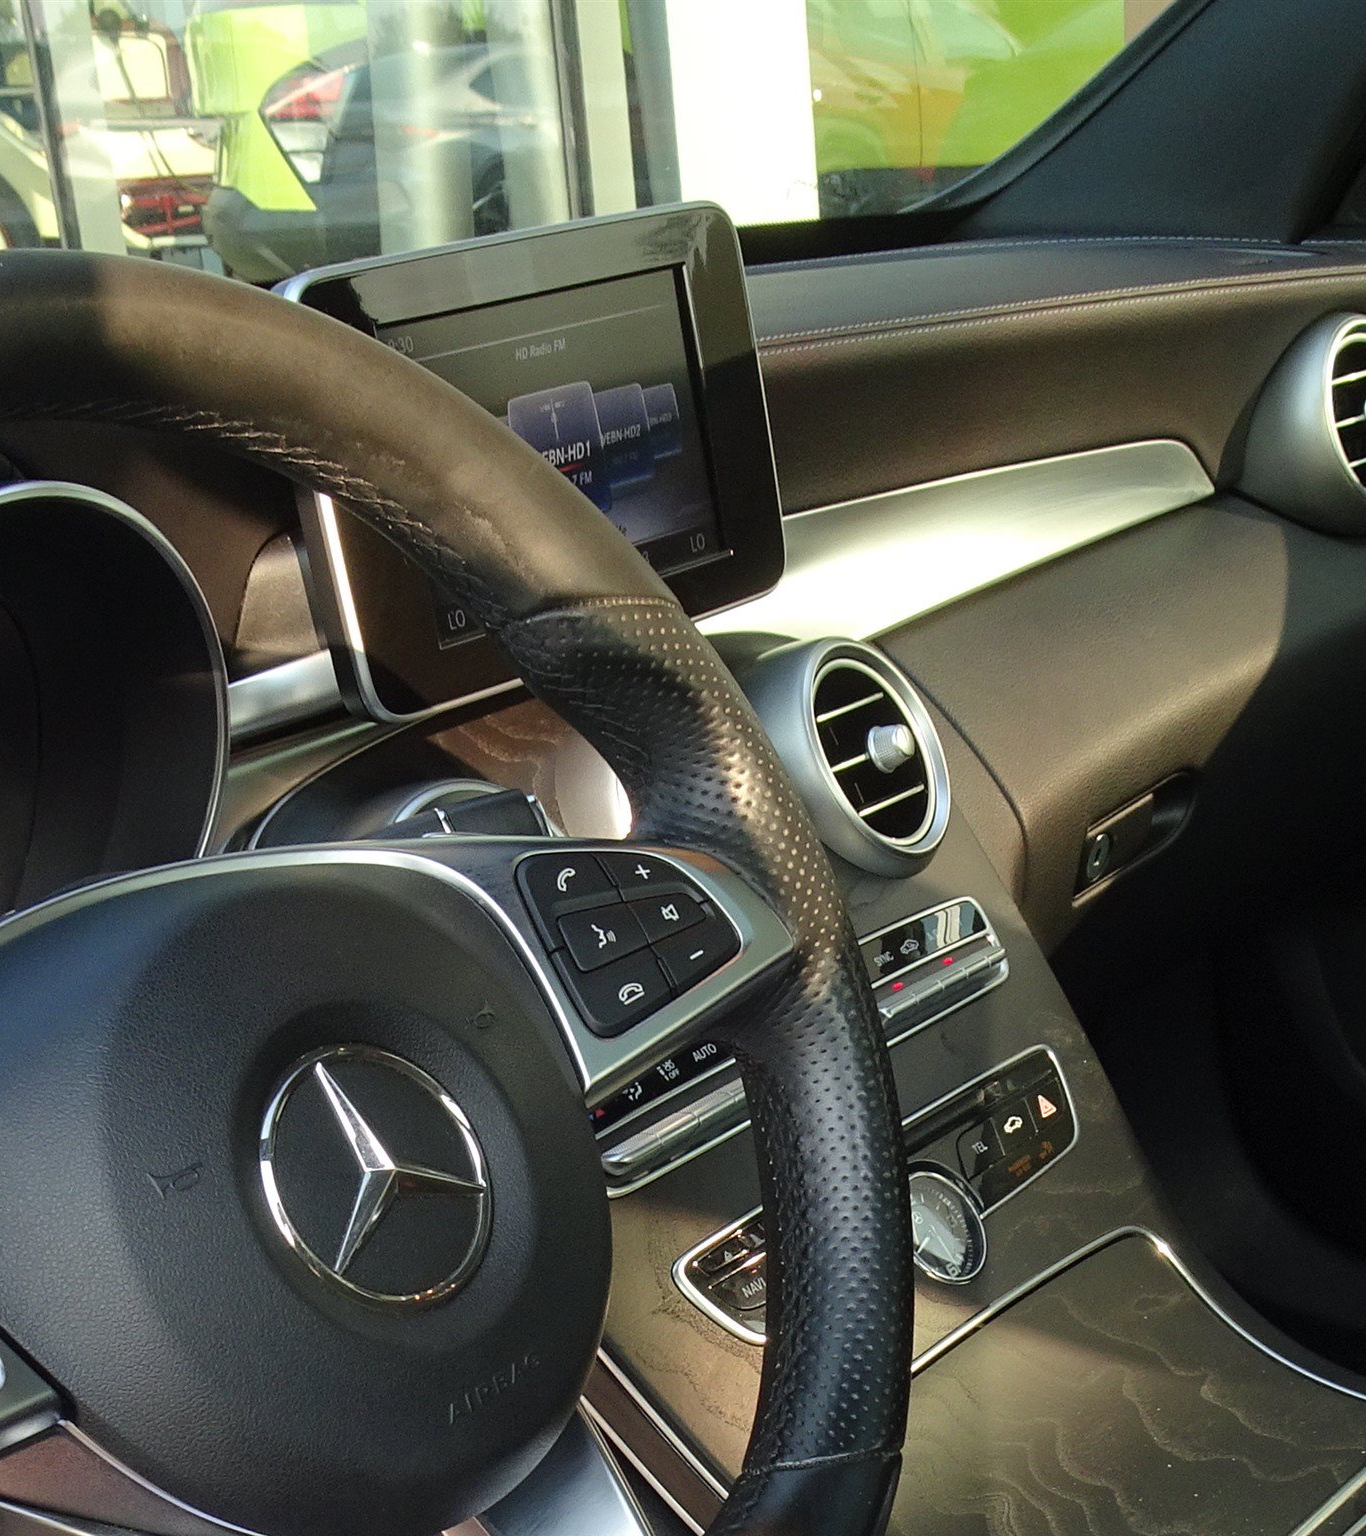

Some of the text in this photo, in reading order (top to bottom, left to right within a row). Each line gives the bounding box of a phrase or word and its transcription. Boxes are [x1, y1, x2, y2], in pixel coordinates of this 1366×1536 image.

[515, 347, 529, 361] HD
[553, 338, 566, 351] FM
[542, 440, 592, 465] EBN-HD1
[690, 533, 706, 553] LO
[447, 609, 466, 630] LO
[692, 1043, 717, 1063] AUTO
[971, 1140, 989, 1155] TEL
